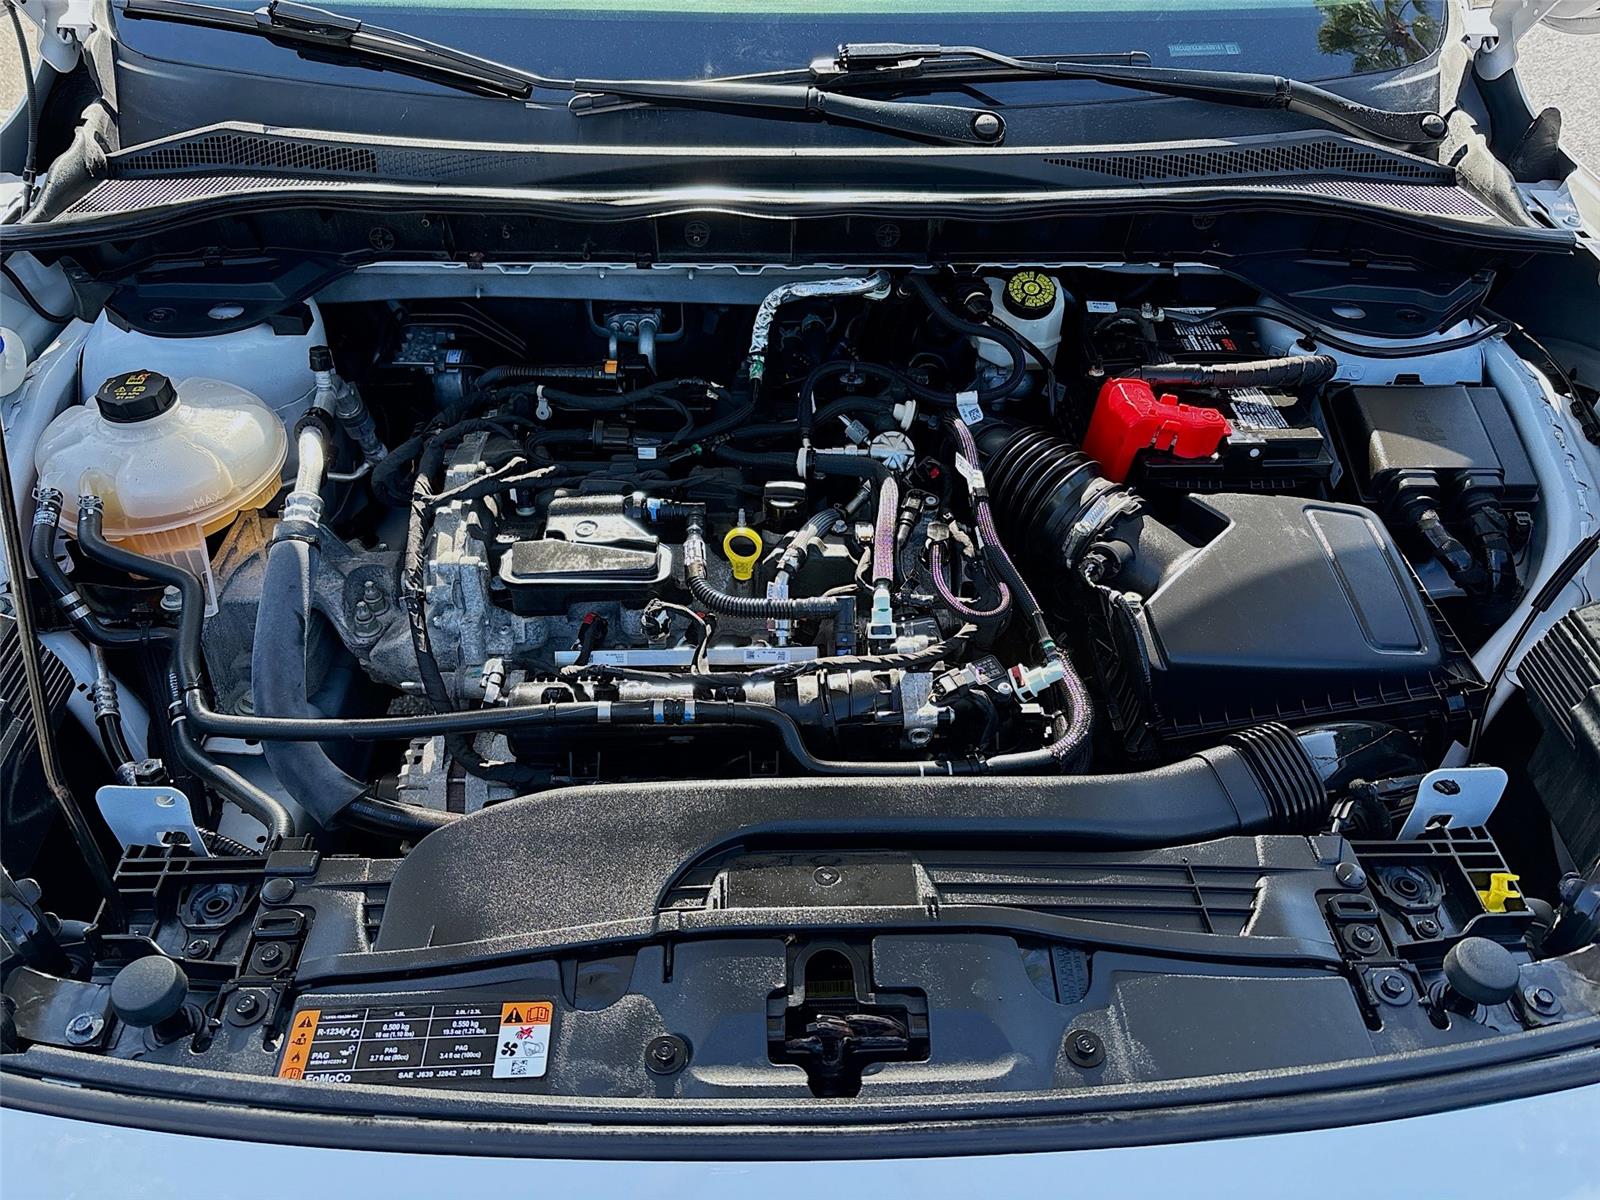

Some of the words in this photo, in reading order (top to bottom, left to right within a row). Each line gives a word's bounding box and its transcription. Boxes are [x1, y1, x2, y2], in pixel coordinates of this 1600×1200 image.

[193, 490, 223, 509] MAX
[382, 1023, 400, 1031] 0.500
[400, 1023, 410, 1031] kg
[452, 1020, 469, 1028] 0.550
[469, 1019, 479, 1028] kg
[317, 1027, 351, 1036] R-1234yf
[305, 1073, 351, 1082] FoMoCo
[398, 1071, 414, 1079] SAE
[416, 1070, 434, 1078] J639
